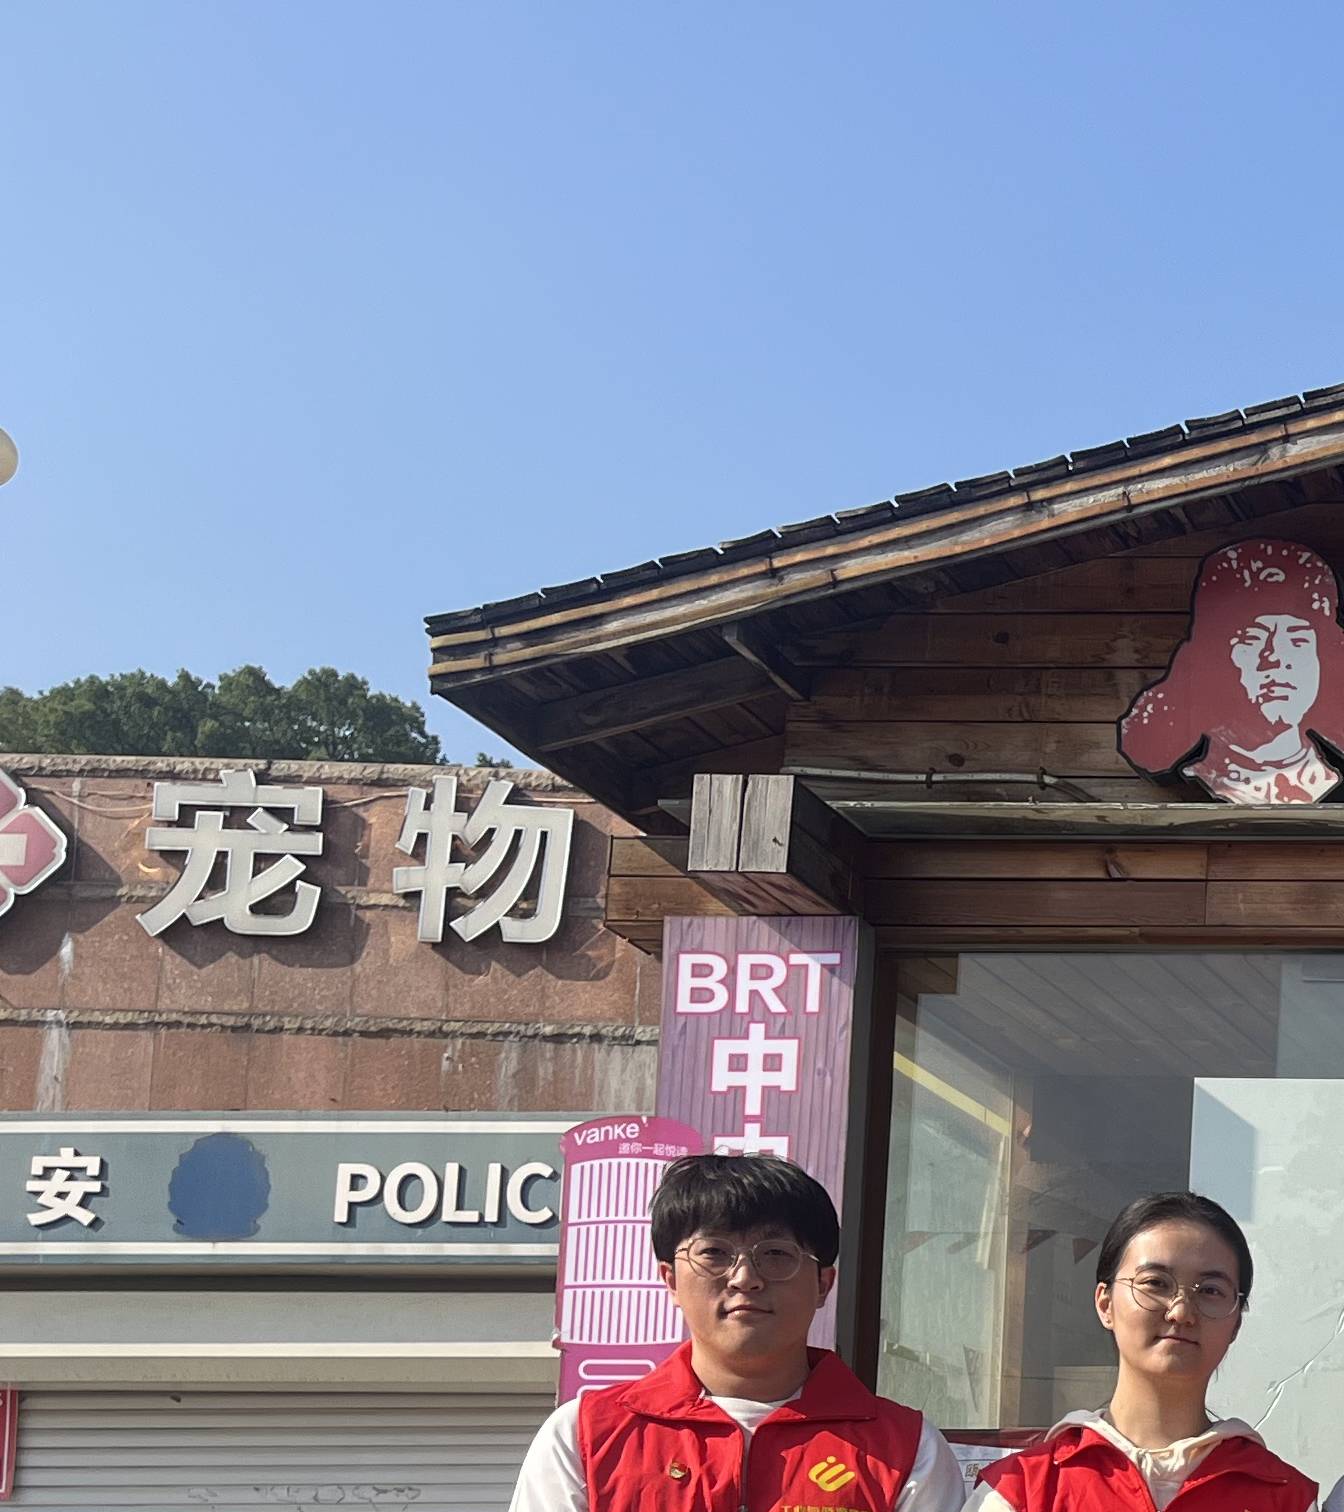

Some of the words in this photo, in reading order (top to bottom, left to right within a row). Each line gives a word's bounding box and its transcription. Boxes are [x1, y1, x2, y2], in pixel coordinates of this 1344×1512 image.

[135, 768, 575, 944] 宠物
[675, 952, 841, 1014] BRT
[25, 1147, 104, 1227] 安
